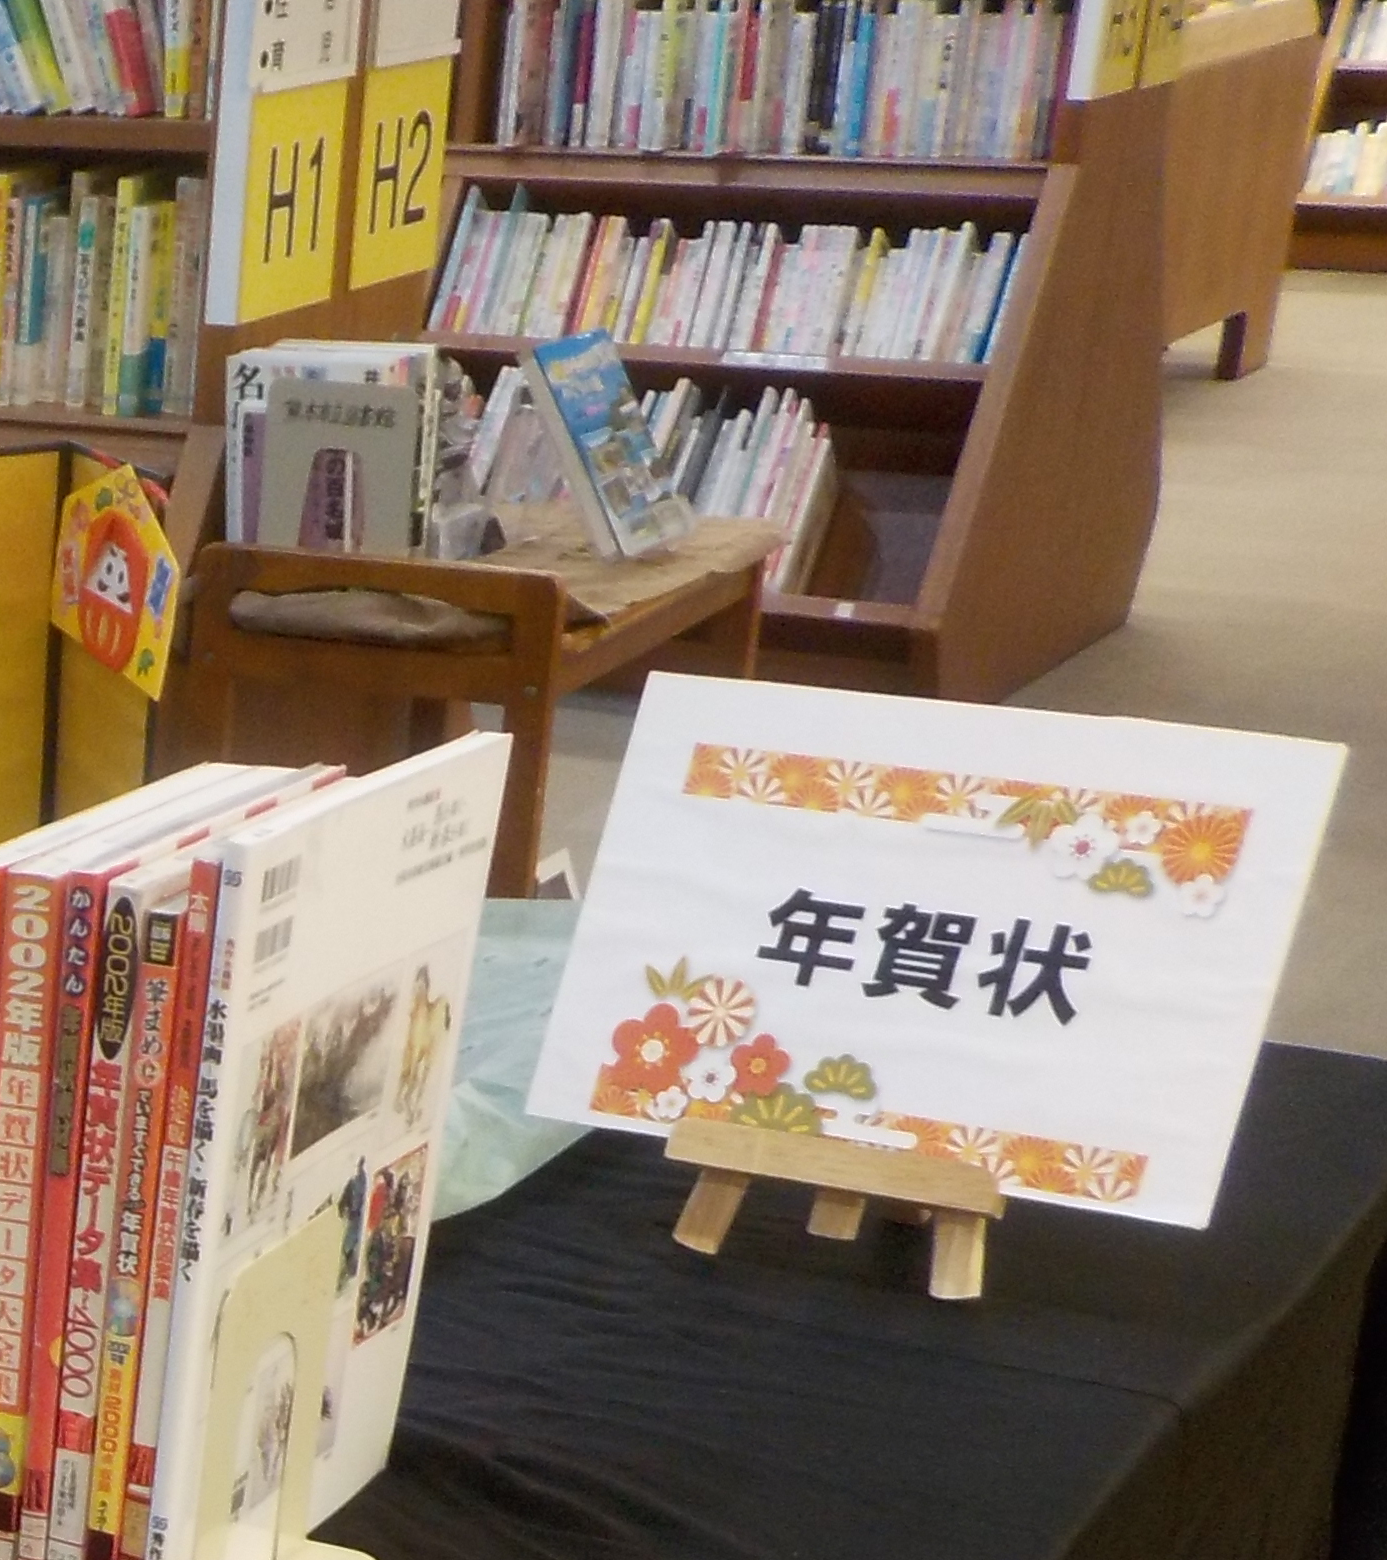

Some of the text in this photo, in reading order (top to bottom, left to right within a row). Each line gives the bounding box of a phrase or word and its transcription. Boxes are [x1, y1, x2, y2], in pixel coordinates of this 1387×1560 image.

[263, 136, 325, 265] H1
[368, 108, 433, 235] H2
[4, 882, 51, 1066] 2002年版
[62, 885, 93, 998] かんたん
[756, 888, 1095, 1026] 年賀状
